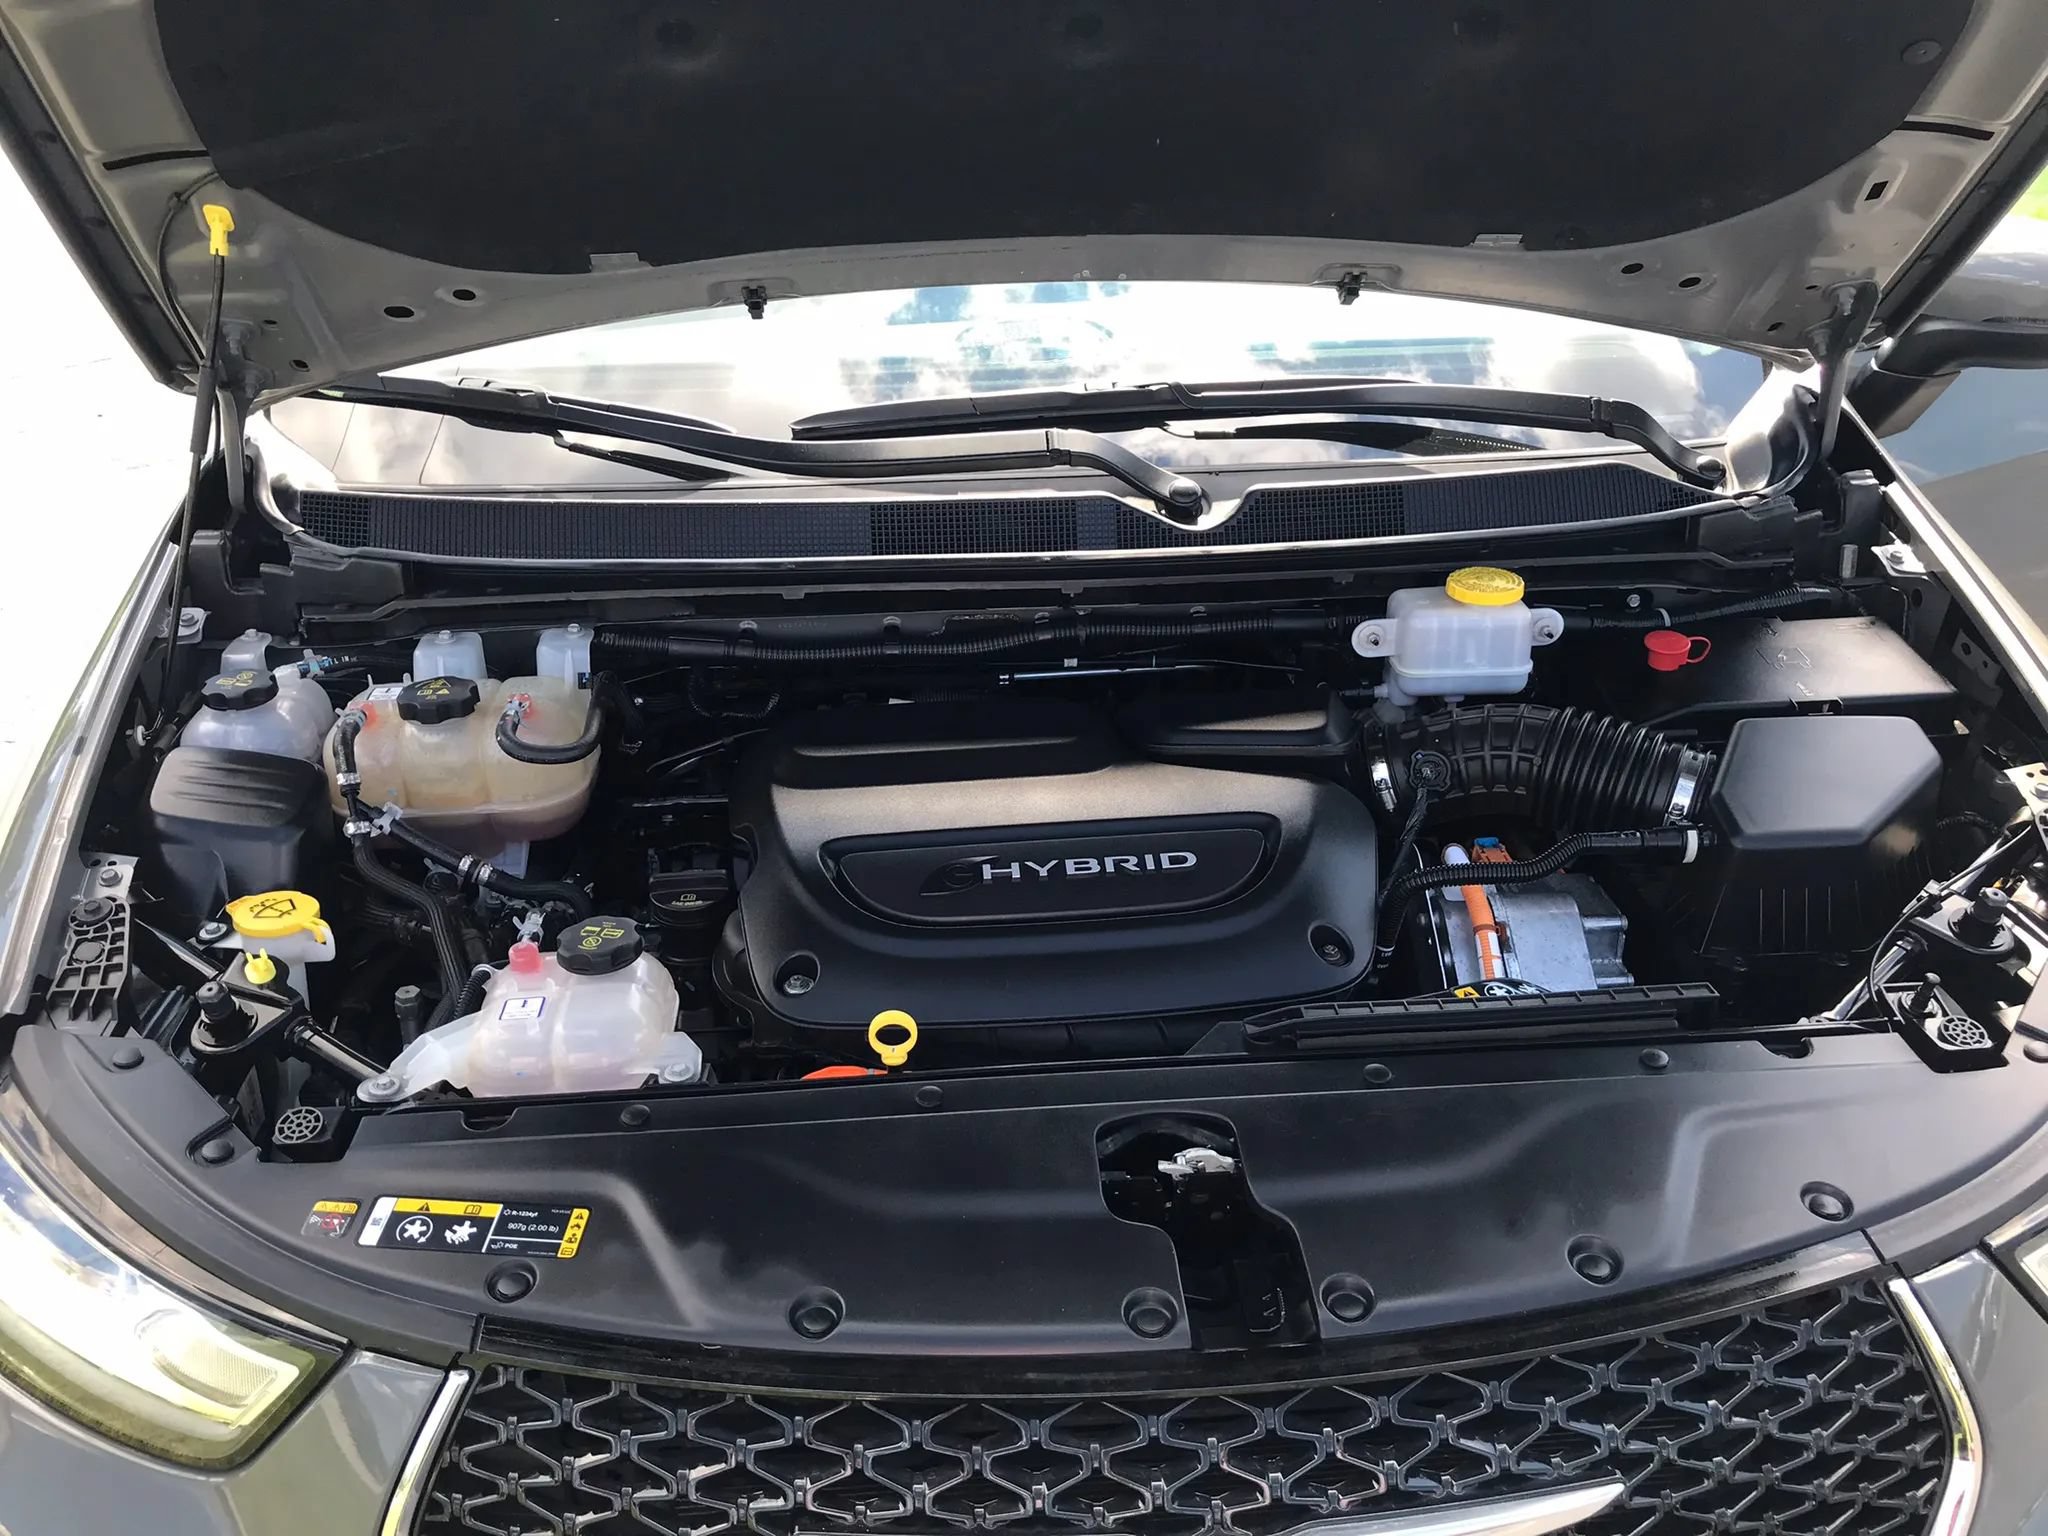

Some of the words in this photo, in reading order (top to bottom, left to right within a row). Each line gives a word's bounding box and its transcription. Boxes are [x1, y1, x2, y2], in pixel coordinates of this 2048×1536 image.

[982, 851, 1198, 880] HYBRID
[507, 1222, 527, 1231] 907g
[527, 1223, 547, 1232] (2.00
[548, 1225, 560, 1234] lb)
